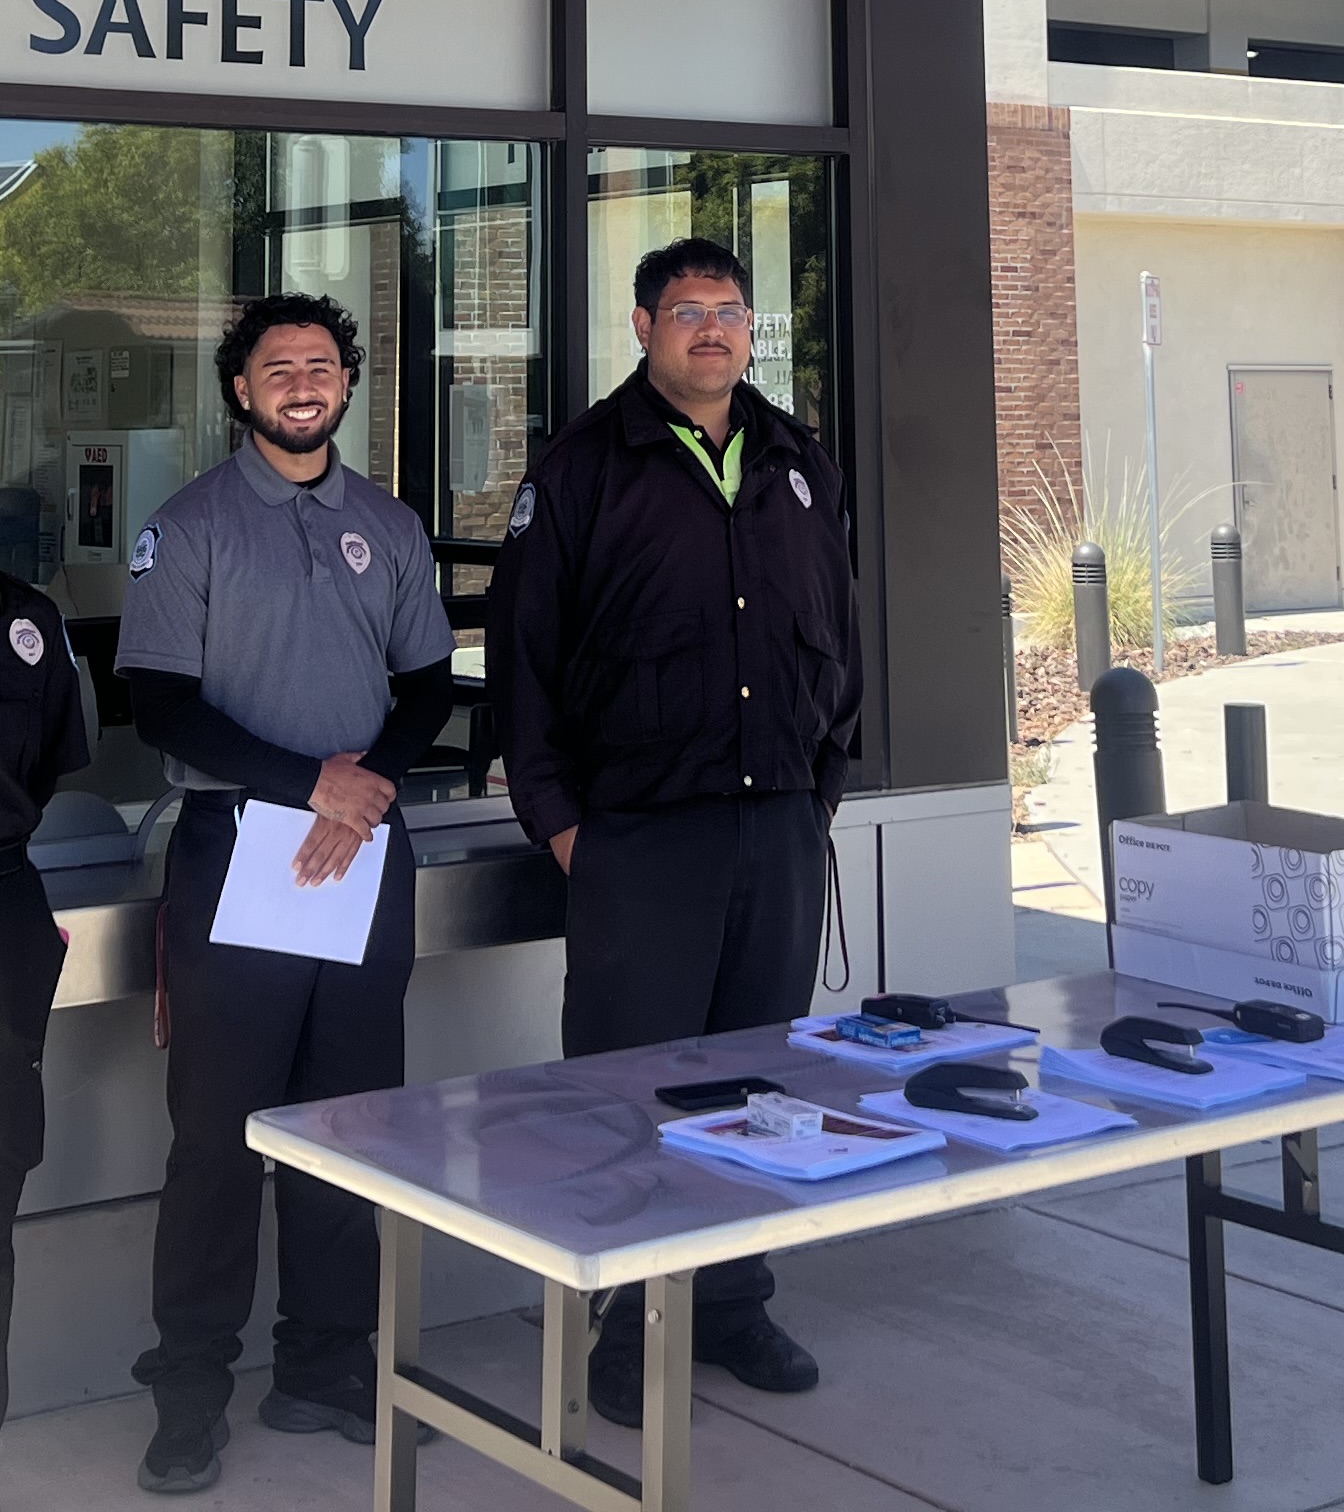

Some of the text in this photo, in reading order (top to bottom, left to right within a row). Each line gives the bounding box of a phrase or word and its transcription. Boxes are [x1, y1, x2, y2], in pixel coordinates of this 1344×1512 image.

[92, 447, 108, 464] AED
[1118, 834, 1144, 848] Office
[1119, 876, 1155, 901] copy
[1283, 982, 1313, 998] Office
